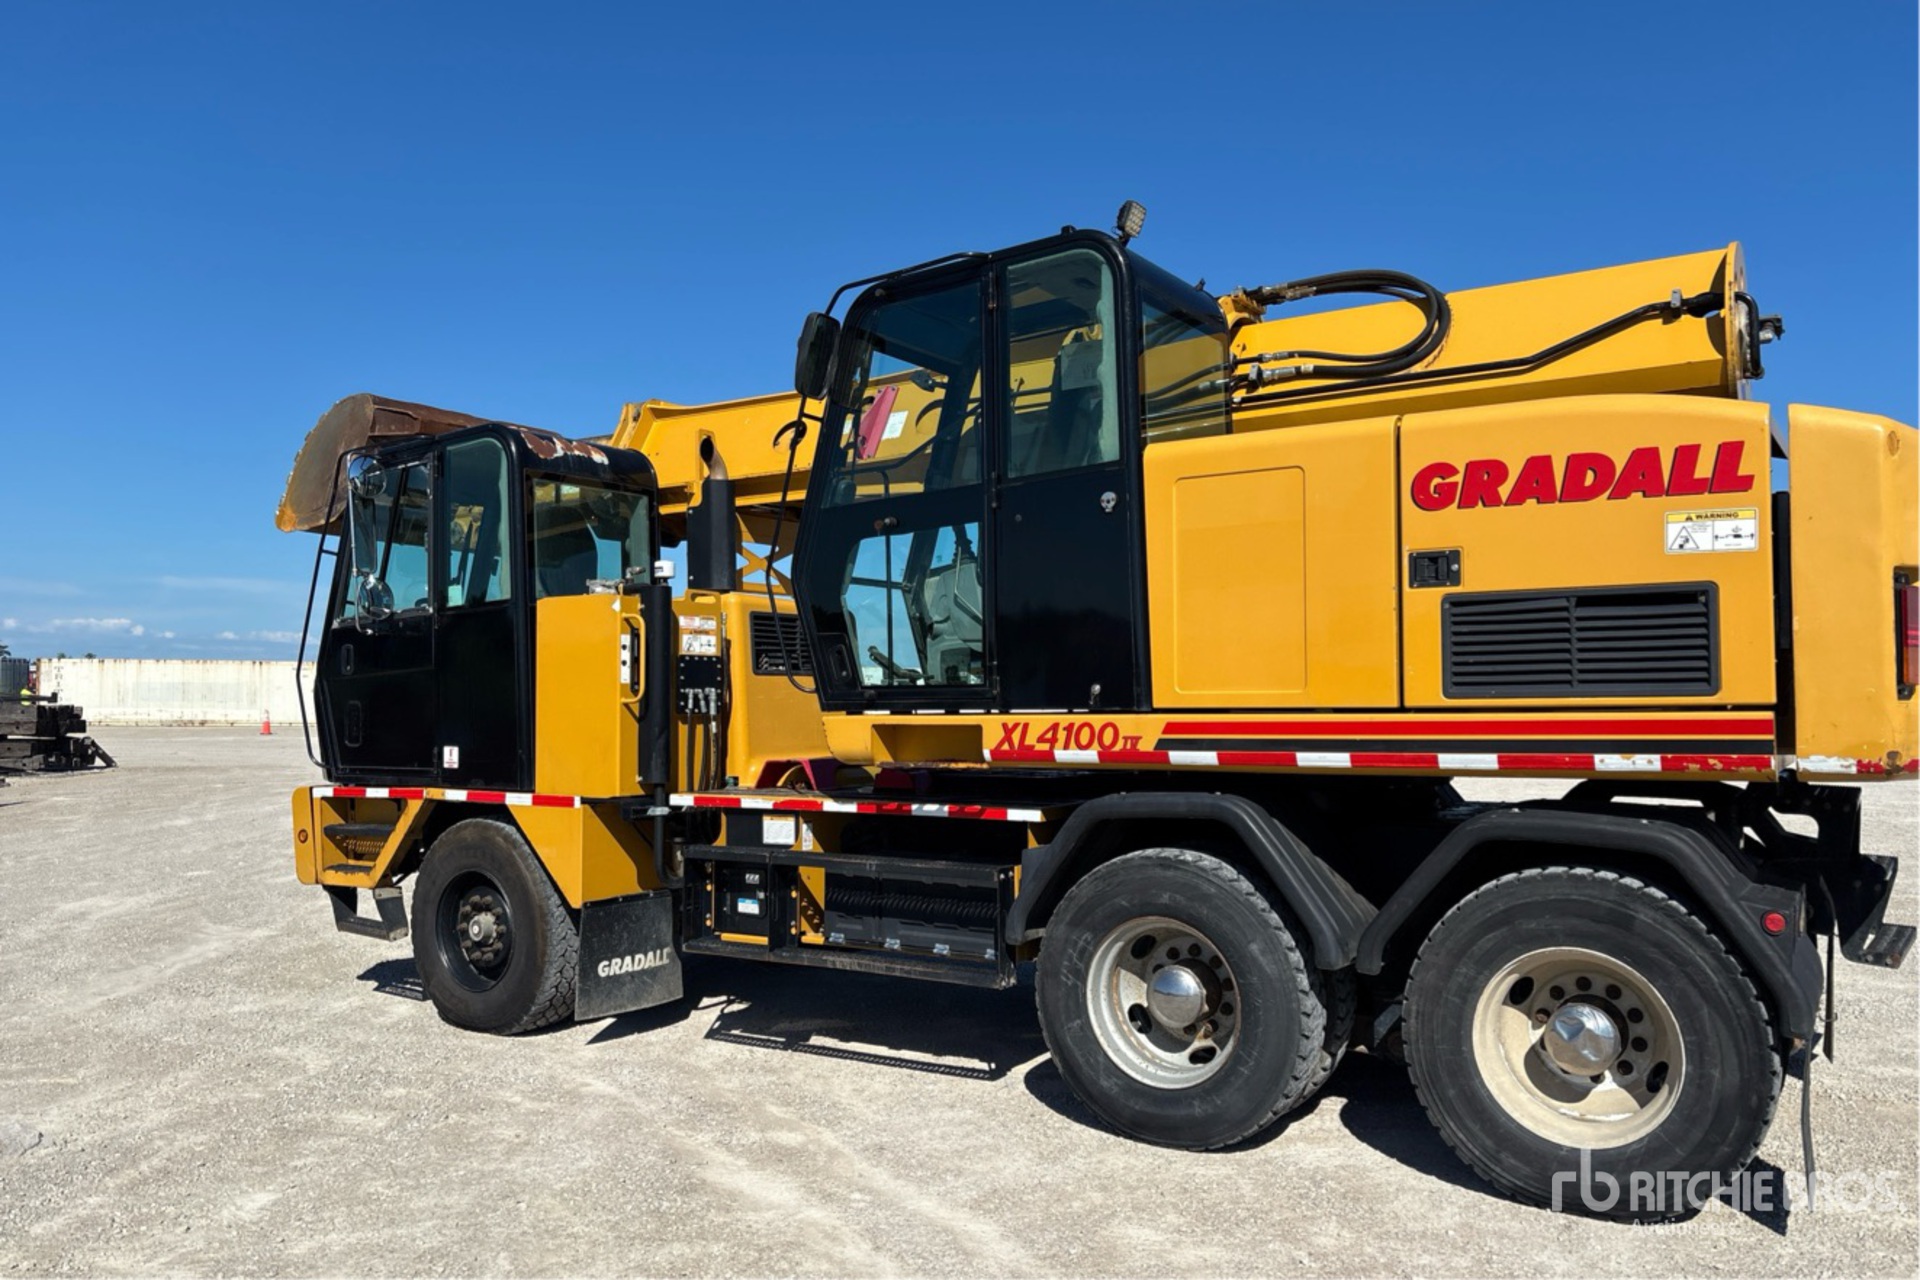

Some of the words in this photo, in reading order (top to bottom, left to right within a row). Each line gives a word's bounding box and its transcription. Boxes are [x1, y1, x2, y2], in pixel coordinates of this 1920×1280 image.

[1411, 441, 1755, 512] GRADALL
[1695, 512, 1739, 520] WARNING
[994, 722, 1120, 751] XL4100
[1119, 736, 1143, 751] IV
[597, 947, 671, 978] GRADALL
